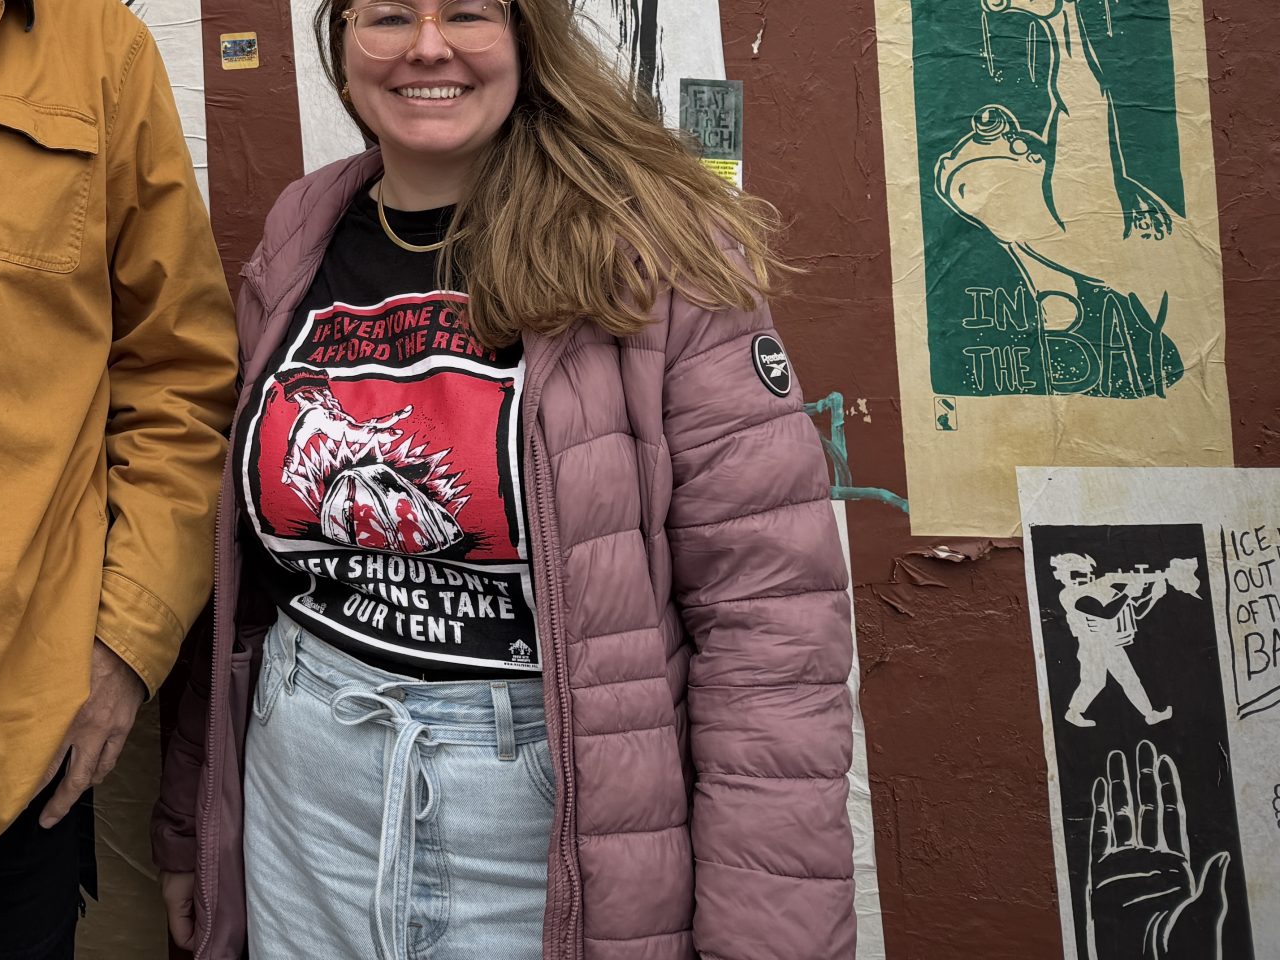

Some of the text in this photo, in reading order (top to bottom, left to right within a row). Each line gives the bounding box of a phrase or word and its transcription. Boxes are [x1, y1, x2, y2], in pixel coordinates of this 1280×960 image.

[693, 89, 729, 109] EAT
[693, 129, 732, 149] ICH
[333, 306, 434, 341] EVERYONE
[439, 308, 471, 330] CA
[962, 285, 1028, 331] IN
[307, 338, 391, 363] AFFORD
[396, 330, 428, 361] THE
[962, 290, 1169, 400] THE BAY
[1231, 525, 1272, 560] ICE
[297, 555, 509, 596] EY SHOULDN'T
[1234, 559, 1275, 593] OUT
[343, 593, 388, 630] OUR
[395, 611, 465, 644] TENT
[439, 591, 515, 620] TAKE
[1237, 599, 1259, 624] OF
